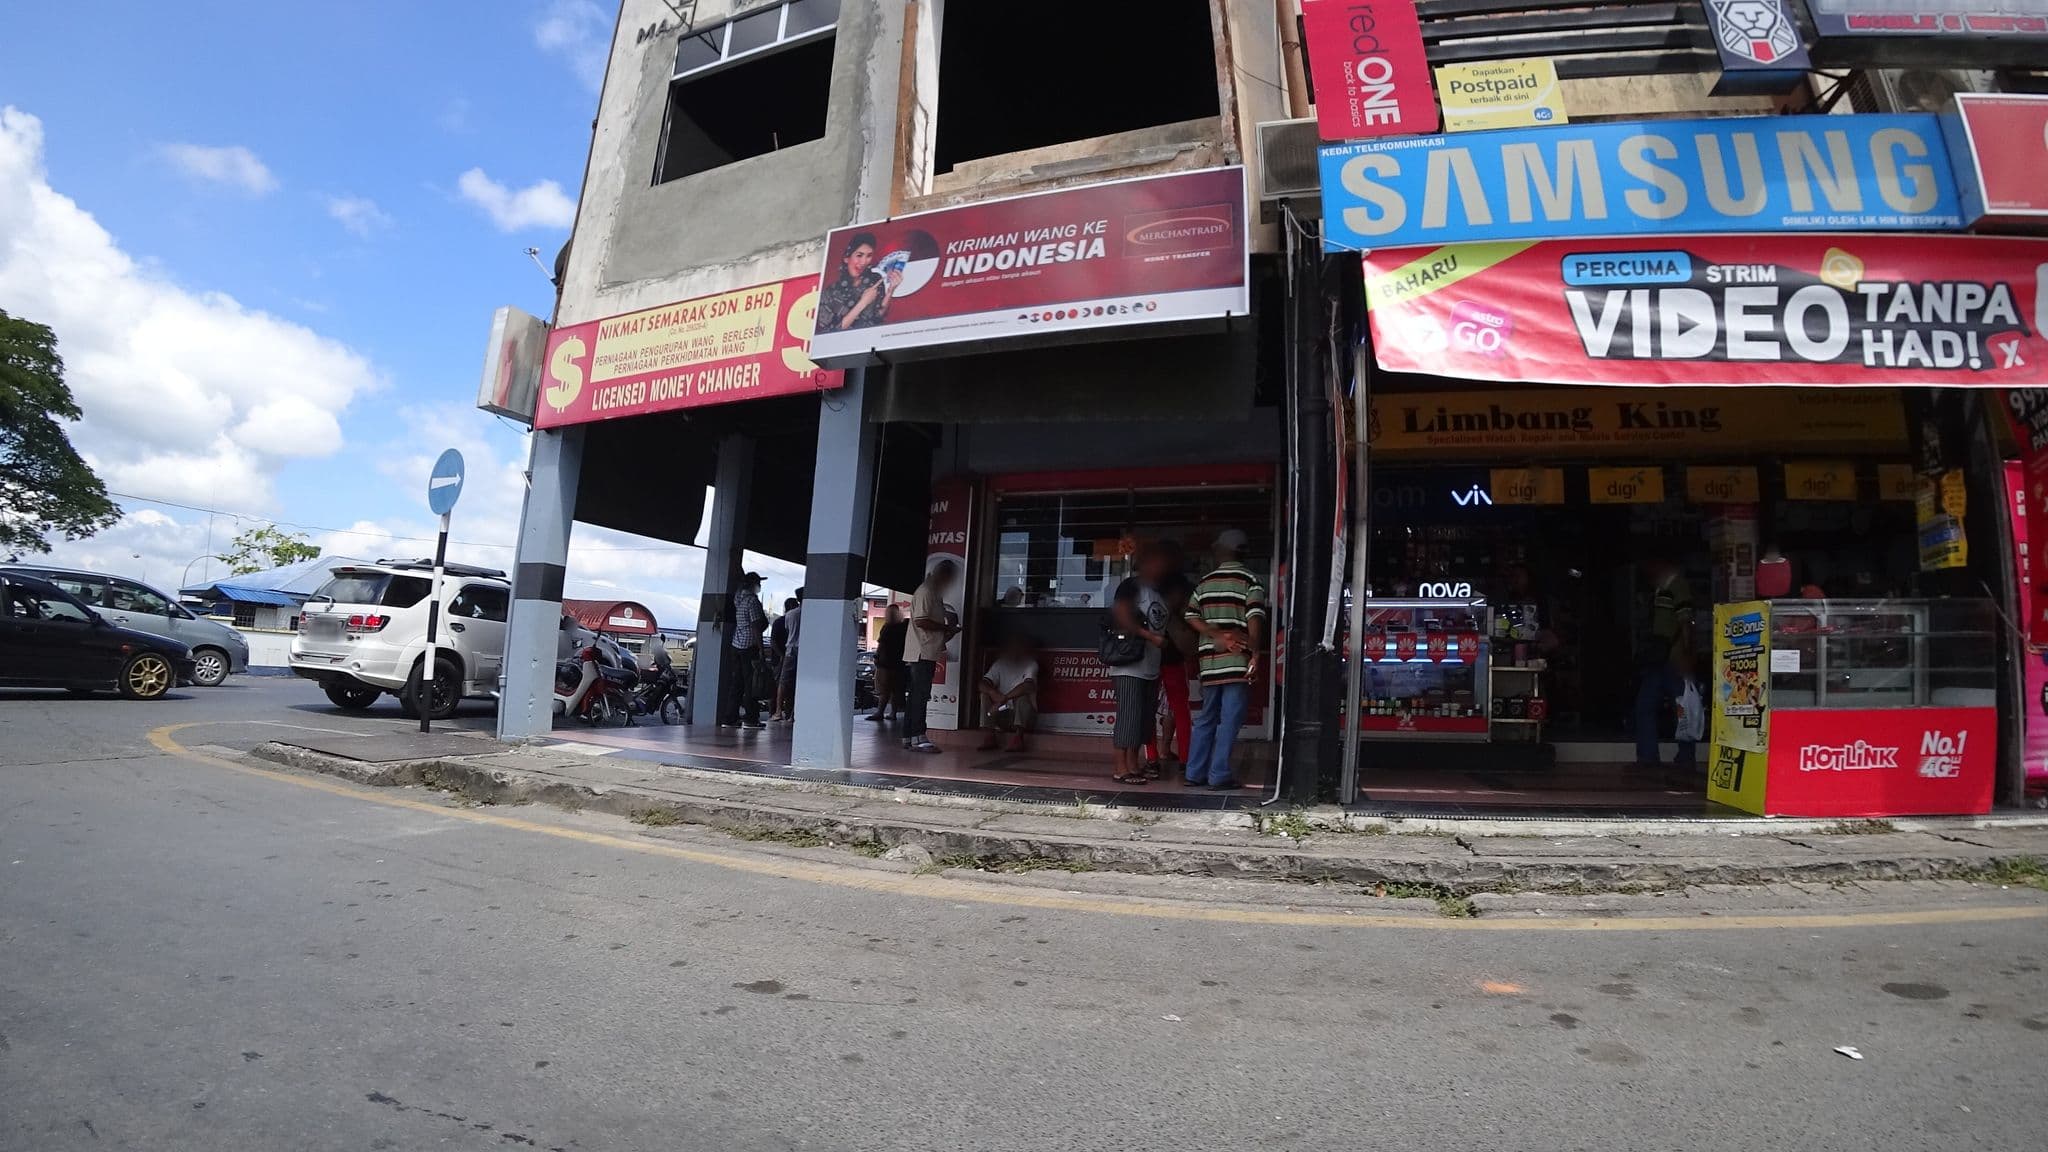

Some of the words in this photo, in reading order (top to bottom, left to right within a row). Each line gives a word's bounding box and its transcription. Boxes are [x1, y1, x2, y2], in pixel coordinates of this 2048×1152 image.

[1471, 66, 1515, 77] Dapatkan
[1450, 73, 1538, 96] Postpaid
[1469, 94, 1501, 105] terbaik
[1503, 93, 1513, 103] di
[1514, 92, 1530, 102] sini
[1322, 147, 1352, 157] KEDAI
[1355, 138, 1445, 153] TELEKOMUNIKASI
[1340, 128, 1939, 237] SAMSUNG
[946, 232, 1022, 254] KIRIMAN
[1024, 223, 1078, 241] WANG
[1082, 220, 1107, 236] KE
[1139, 224, 1224, 241] MERCHANTRADE
[942, 237, 1106, 278] INDONESIA
[1144, 254, 1170, 263] MONEY
[1172, 250, 1211, 260] TRANSFER
[1382, 254, 1457, 298] BAHARU
[1575, 261, 1680, 279] PERCUMA
[1705, 264, 1777, 283] STRIM
[1856, 282, 2020, 325] TANPA
[600, 318, 646, 341] NIKMAT
[647, 304, 707, 332] SEMARAK
[710, 298, 742, 319] SDN.
[744, 291, 777, 311] BHD.
[1471, 311, 1505, 328] astro
[1565, 286, 1850, 360] VIDEO
[595, 349, 637, 367] PERNIAGAAN
[640, 340, 689, 358] PENGURUPAN
[691, 335, 714, 347] WANG
[722, 325, 766, 343] BERLESEN
[1454, 321, 1501, 352] GO
[613, 357, 658, 375] PERNIAGAAN
[660, 347, 719, 367] PERKHIDMATAN
[721, 341, 746, 355] WANG
[1863, 330, 1982, 369] HAD!
[591, 382, 647, 411] LICENSED
[650, 373, 694, 402] MONEY
[697, 362, 761, 395] CHANGER
[1402, 406, 1593, 433] Limbang
[1617, 402, 1722, 433] King
[1508, 482, 1538, 498] digi
[1607, 482, 1637, 498] digi
[1705, 480, 1734, 497] digi
[1419, 582, 1471, 598] nova
[1054, 657, 1079, 665] SEND
[1081, 658, 1106, 666] MON
[1101, 690, 1117, 699] IN
[1920, 730, 1968, 755] No.1
[1919, 756, 1952, 778] 4G
